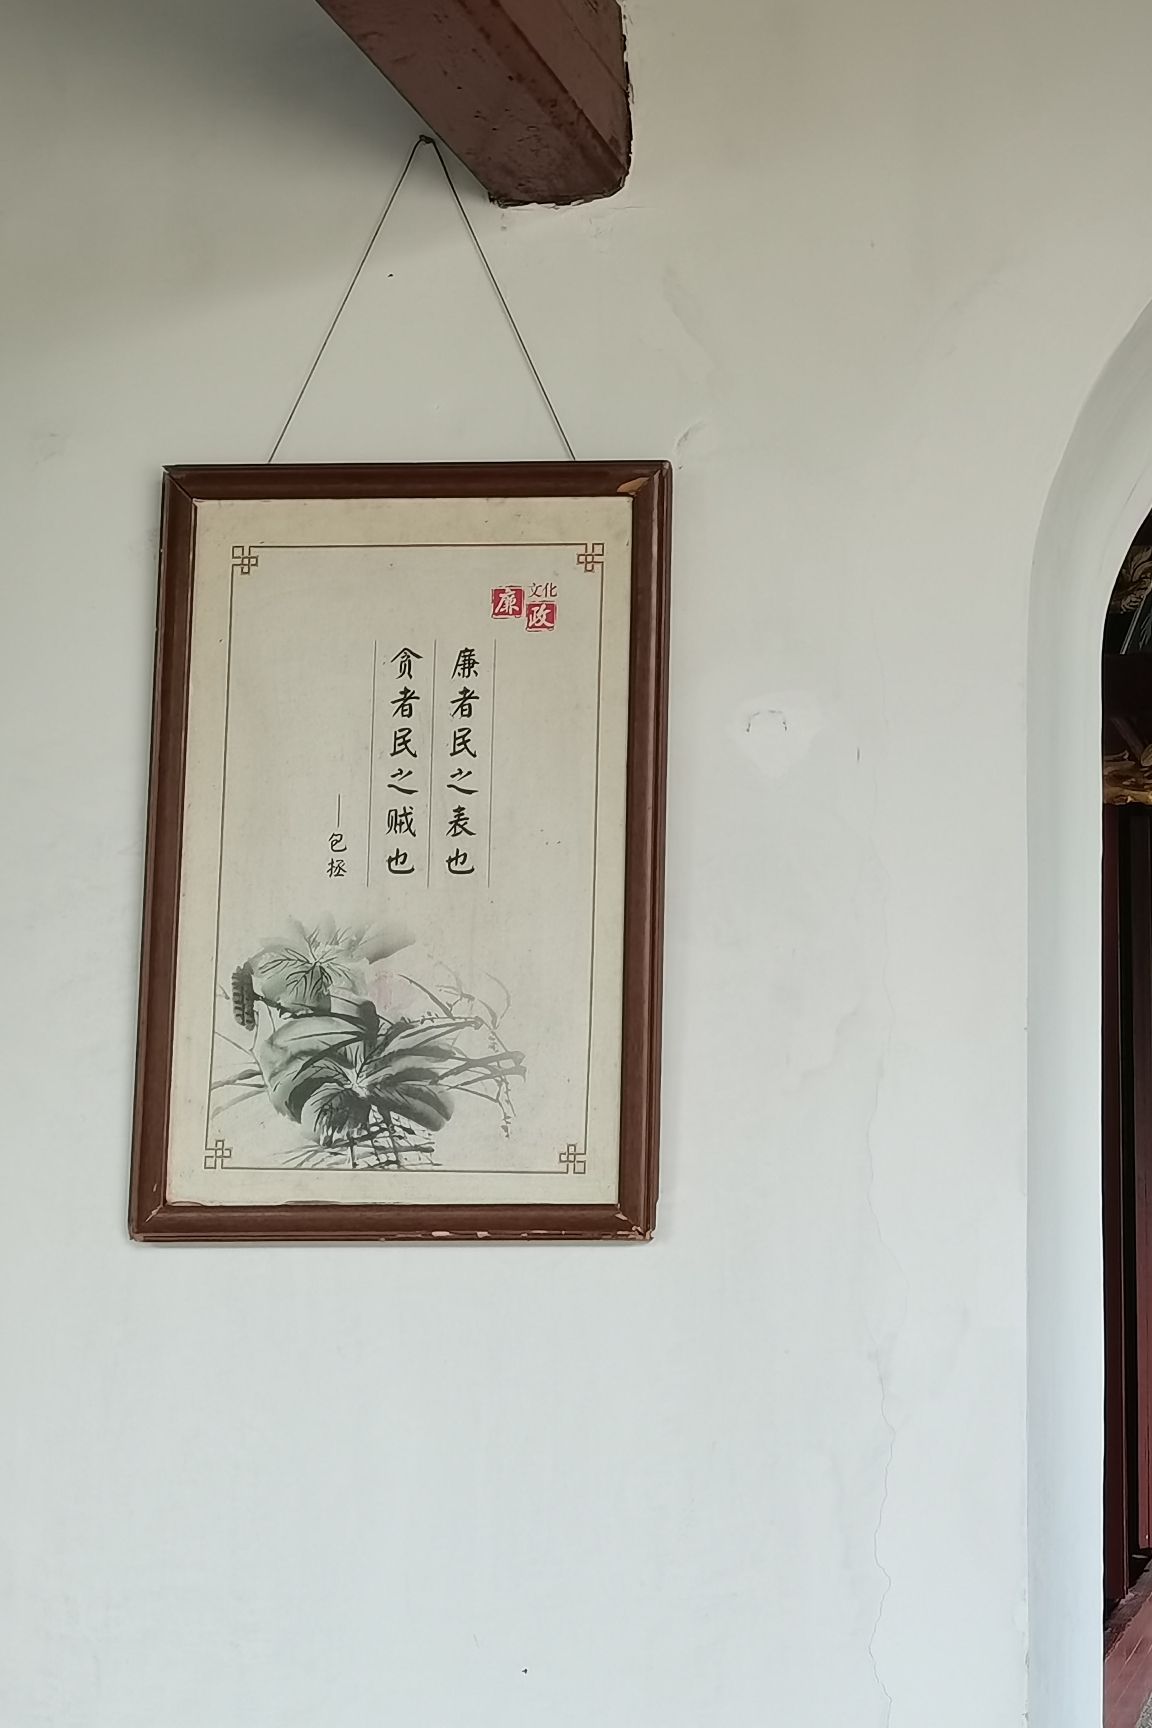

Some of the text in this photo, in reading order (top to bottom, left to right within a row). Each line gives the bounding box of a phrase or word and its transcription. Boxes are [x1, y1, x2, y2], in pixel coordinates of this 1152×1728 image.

[528, 582, 558, 598] 文化
[385, 647, 423, 875] 贪者民之贼也
[445, 647, 480, 875] 廉者民之表也
